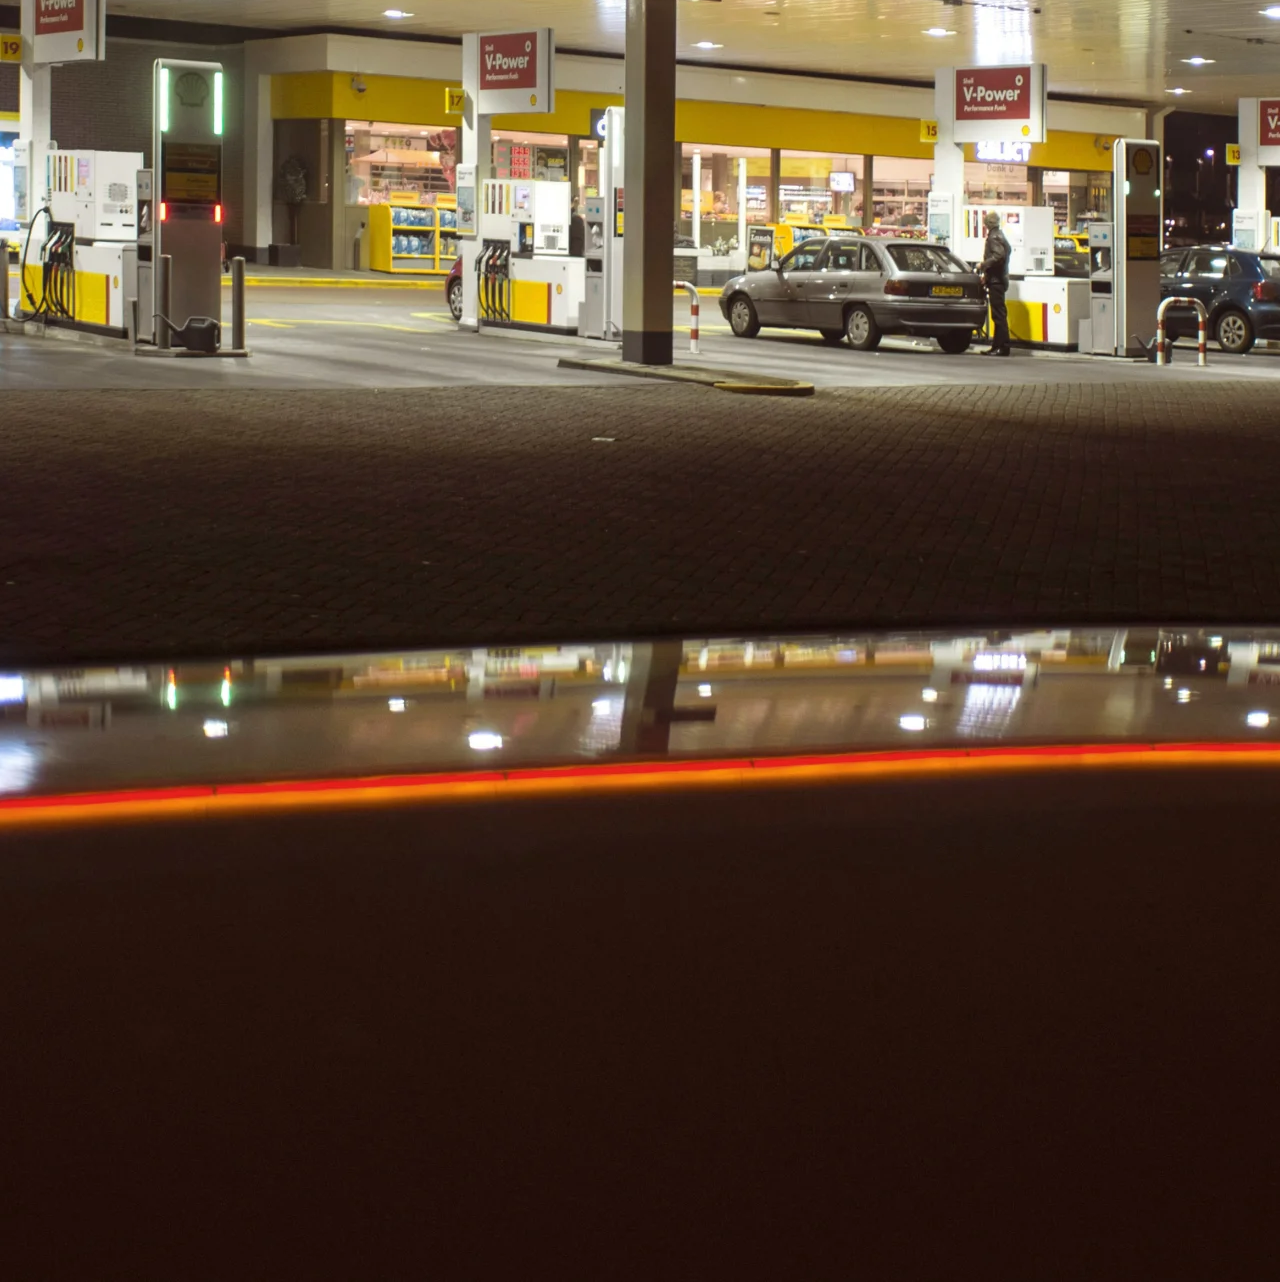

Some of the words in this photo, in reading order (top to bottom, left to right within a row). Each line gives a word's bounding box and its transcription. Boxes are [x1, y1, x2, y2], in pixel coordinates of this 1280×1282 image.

[3, 41, 20, 55] 19
[485, 53, 530, 70] V-Power
[963, 77, 974, 85] Shell
[963, 86, 1021, 102] V-Power
[450, 94, 463, 107] 17
[964, 104, 994, 112] Performance
[926, 125, 938, 137] 15
[1232, 149, 1240, 160] 13
[751, 233, 772, 243] Lunch
